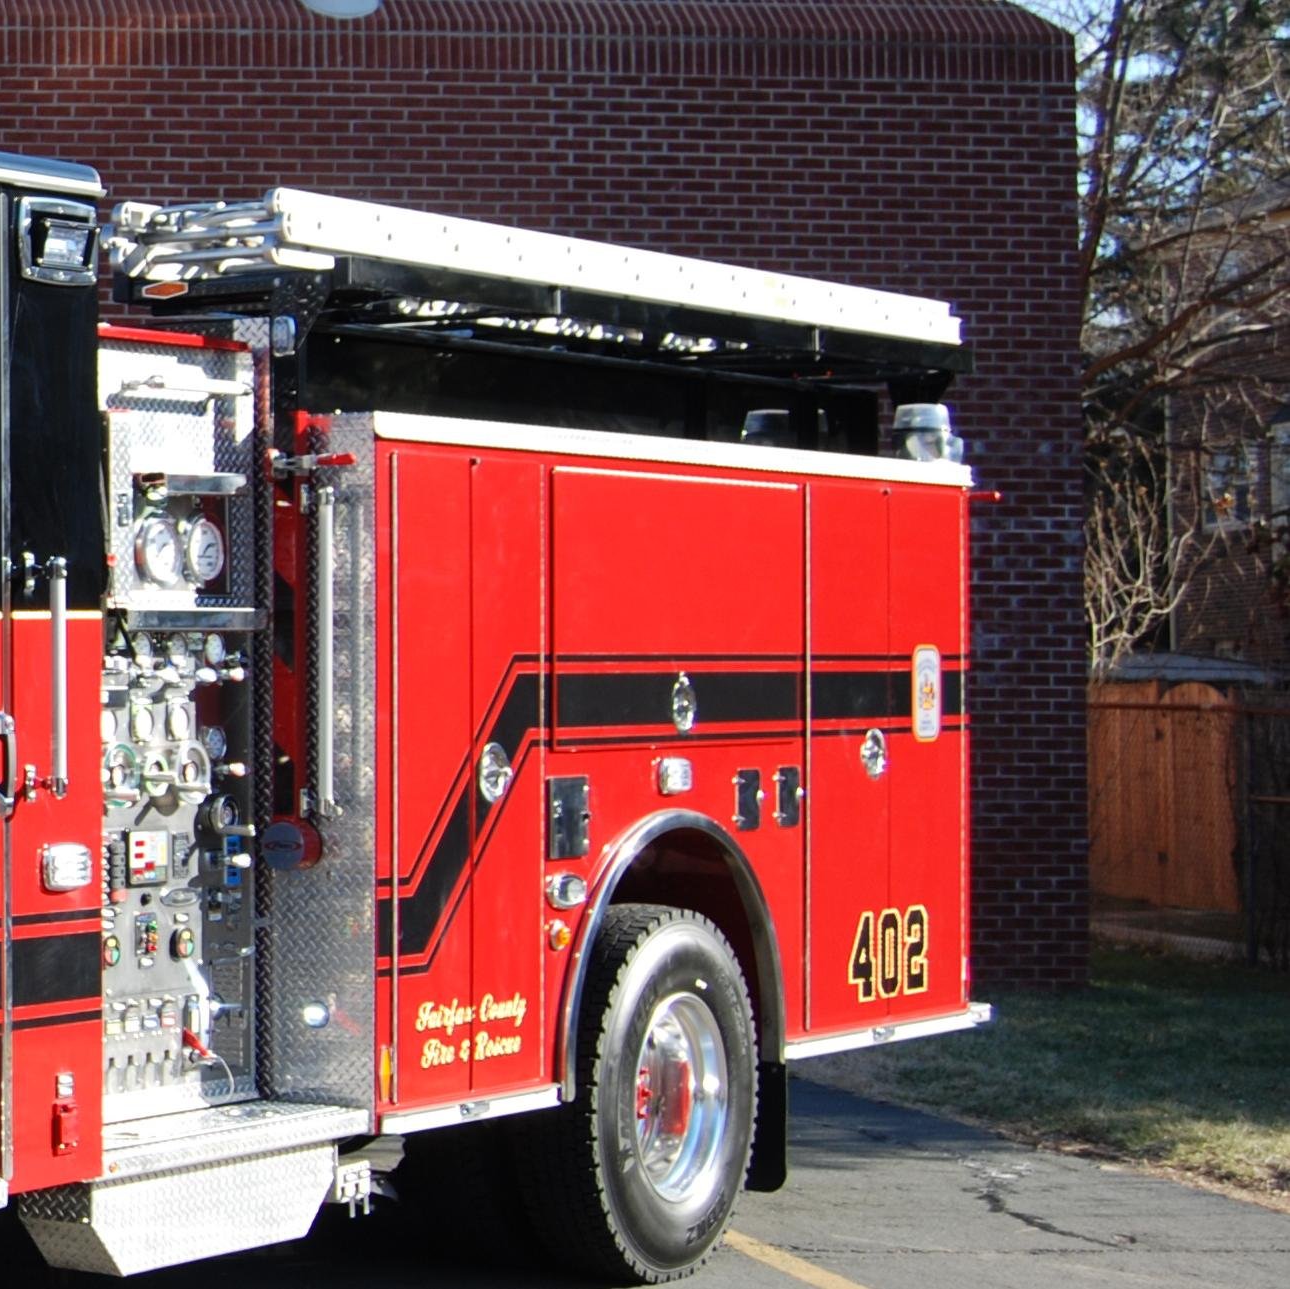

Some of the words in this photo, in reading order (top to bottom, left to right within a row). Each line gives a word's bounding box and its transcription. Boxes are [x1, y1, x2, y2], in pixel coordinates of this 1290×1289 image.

[847, 903, 930, 1004] 402
[415, 998, 476, 1036] Fairfax
[479, 991, 527, 1028] County
[421, 1037, 455, 1069] Fire
[473, 1030, 522, 1061] Rescue
